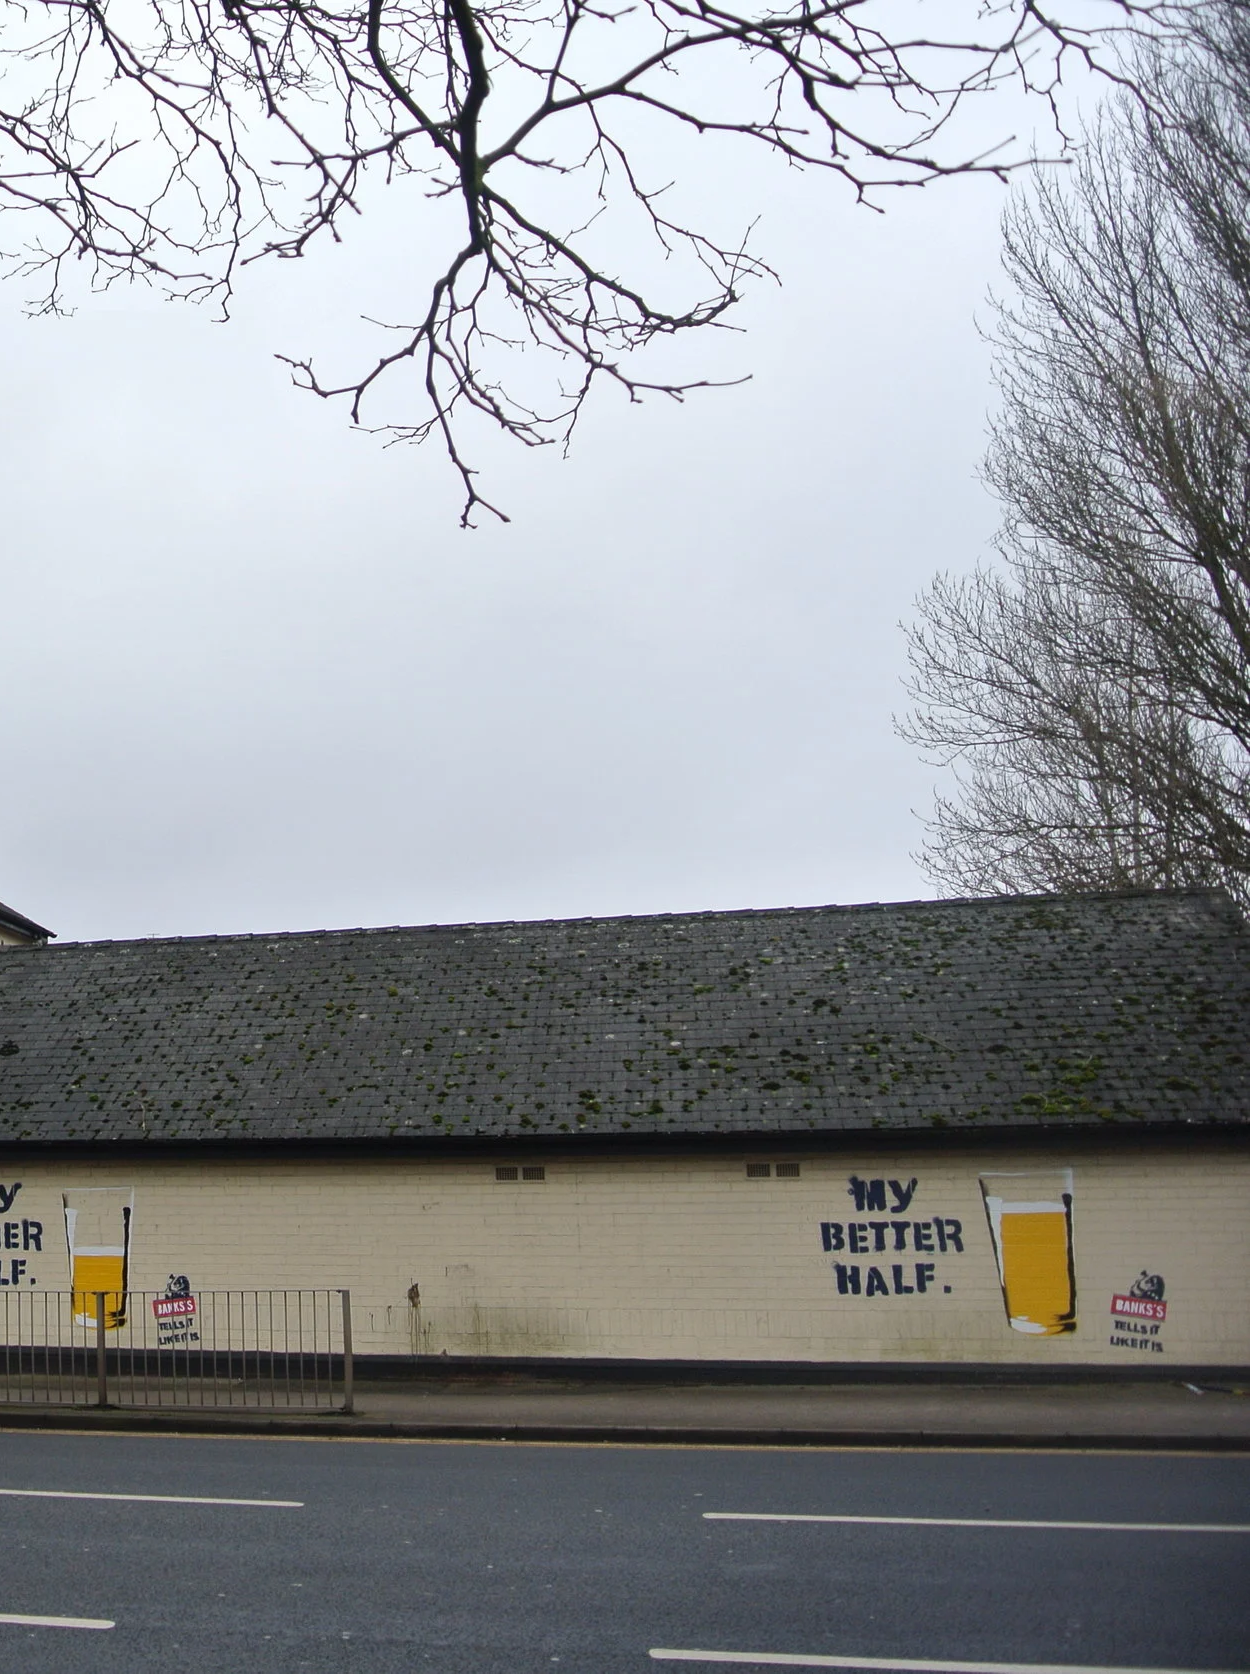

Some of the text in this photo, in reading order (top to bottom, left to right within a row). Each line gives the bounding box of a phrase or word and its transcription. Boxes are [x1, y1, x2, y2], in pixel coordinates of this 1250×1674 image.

[849, 1176, 918, 1213] MY
[820, 1217, 964, 1254] BETTER
[834, 1262, 952, 1297] HALF.
[1115, 1299, 1164, 1318] BANKS'S
[190, 1332, 200, 1341] IS
[1114, 1320, 1148, 1335] TELLS
[1110, 1335, 1138, 1349] LIKE
